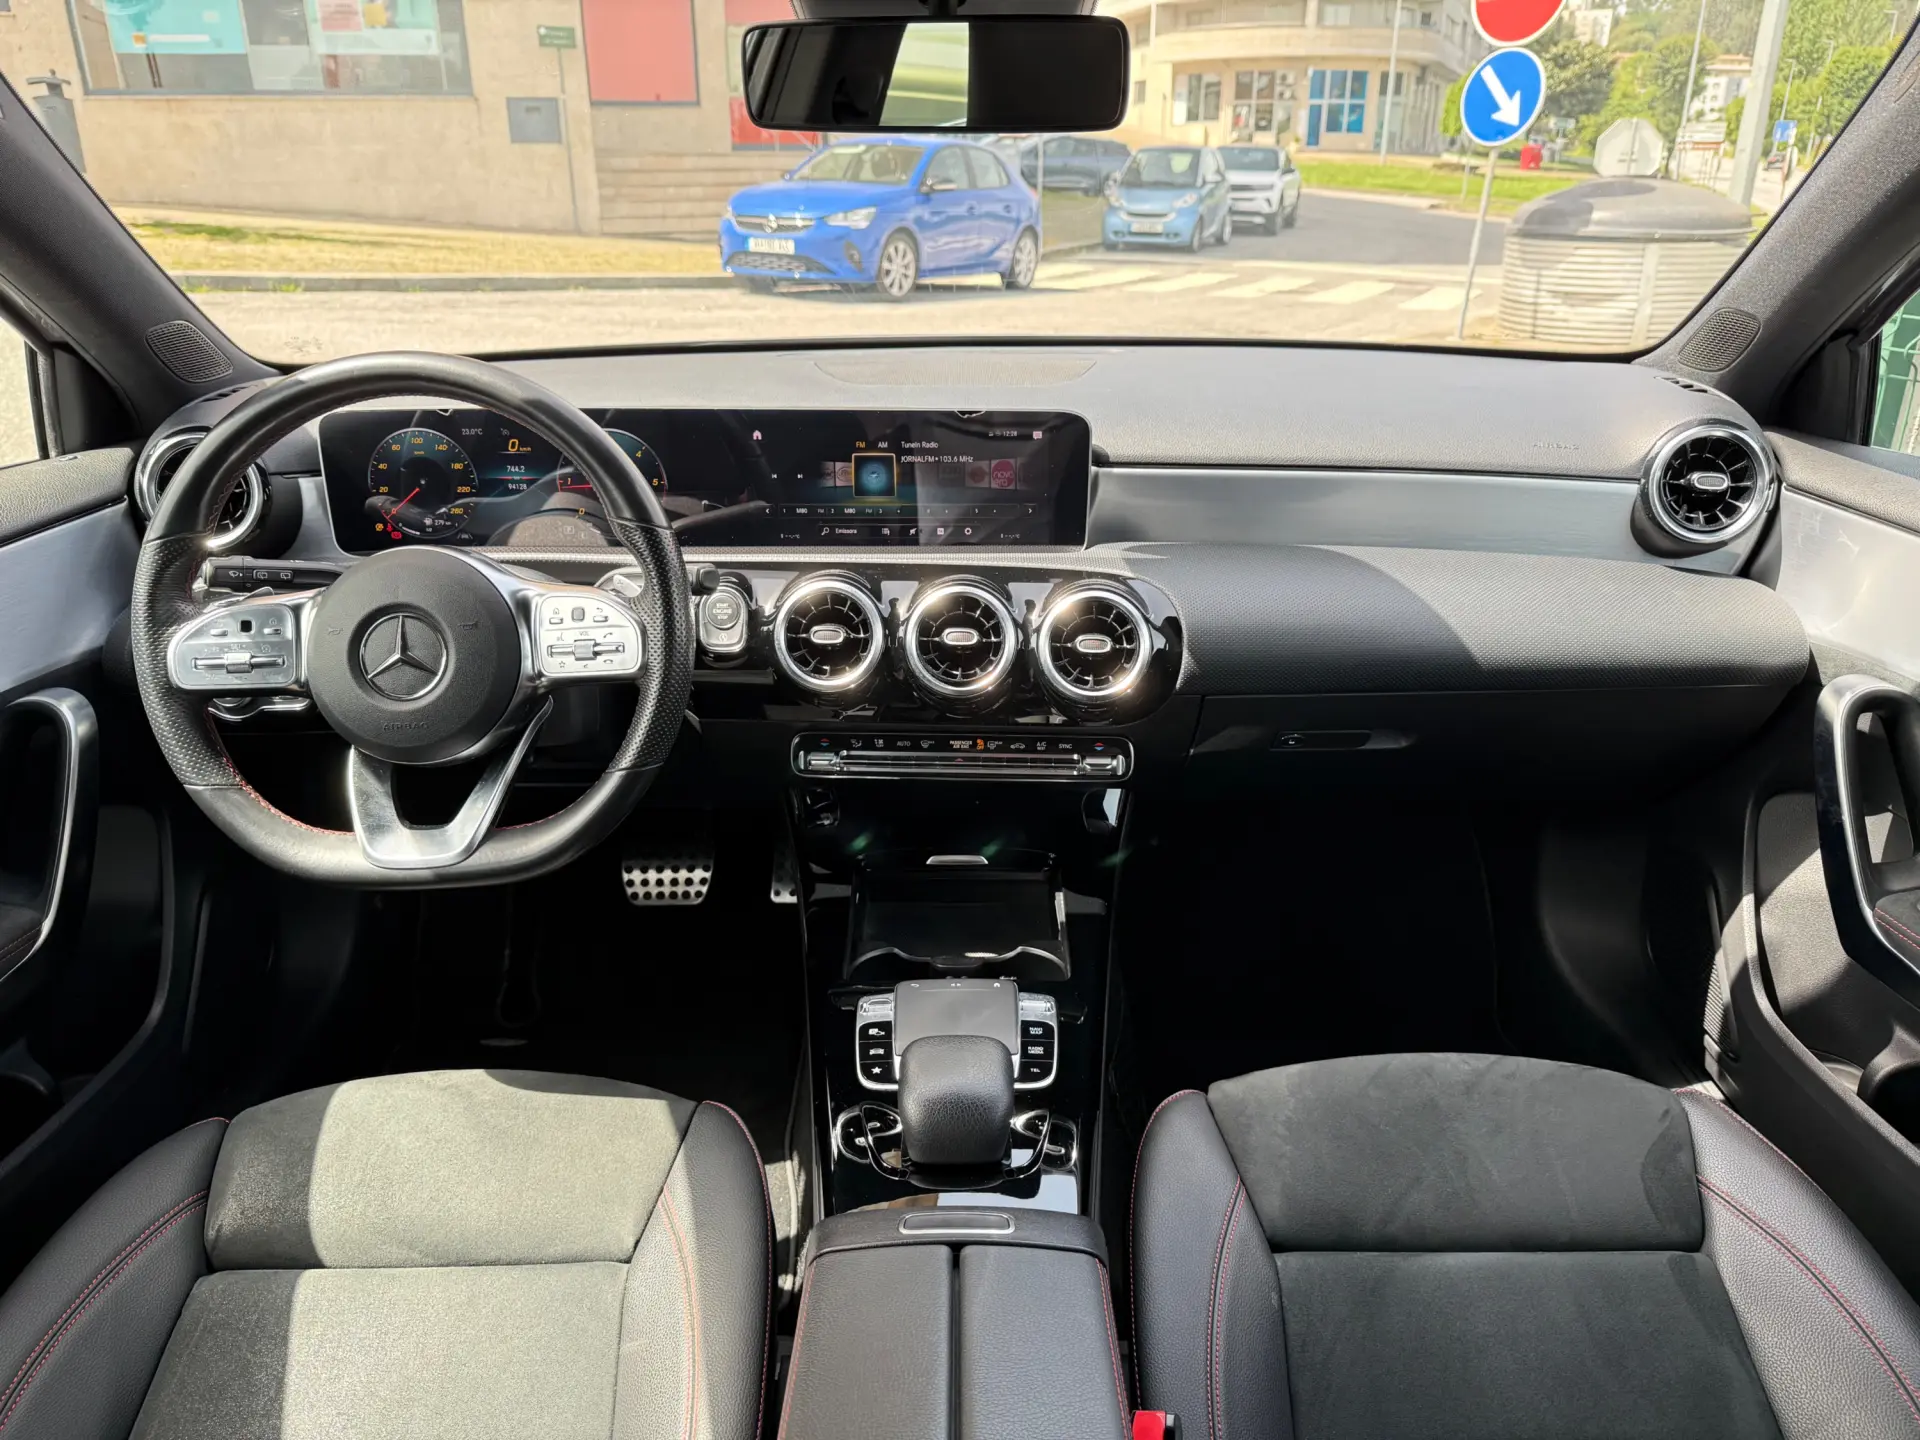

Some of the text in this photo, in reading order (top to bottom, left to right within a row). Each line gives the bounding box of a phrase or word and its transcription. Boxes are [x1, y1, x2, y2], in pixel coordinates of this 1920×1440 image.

[508, 438, 519, 452] 0
[959, 455, 974, 463] MHz
[566, 477, 571, 485] 1
[652, 478, 659, 486] 5
[577, 507, 585, 515] 0
[383, 721, 430, 731] AIRBAG
